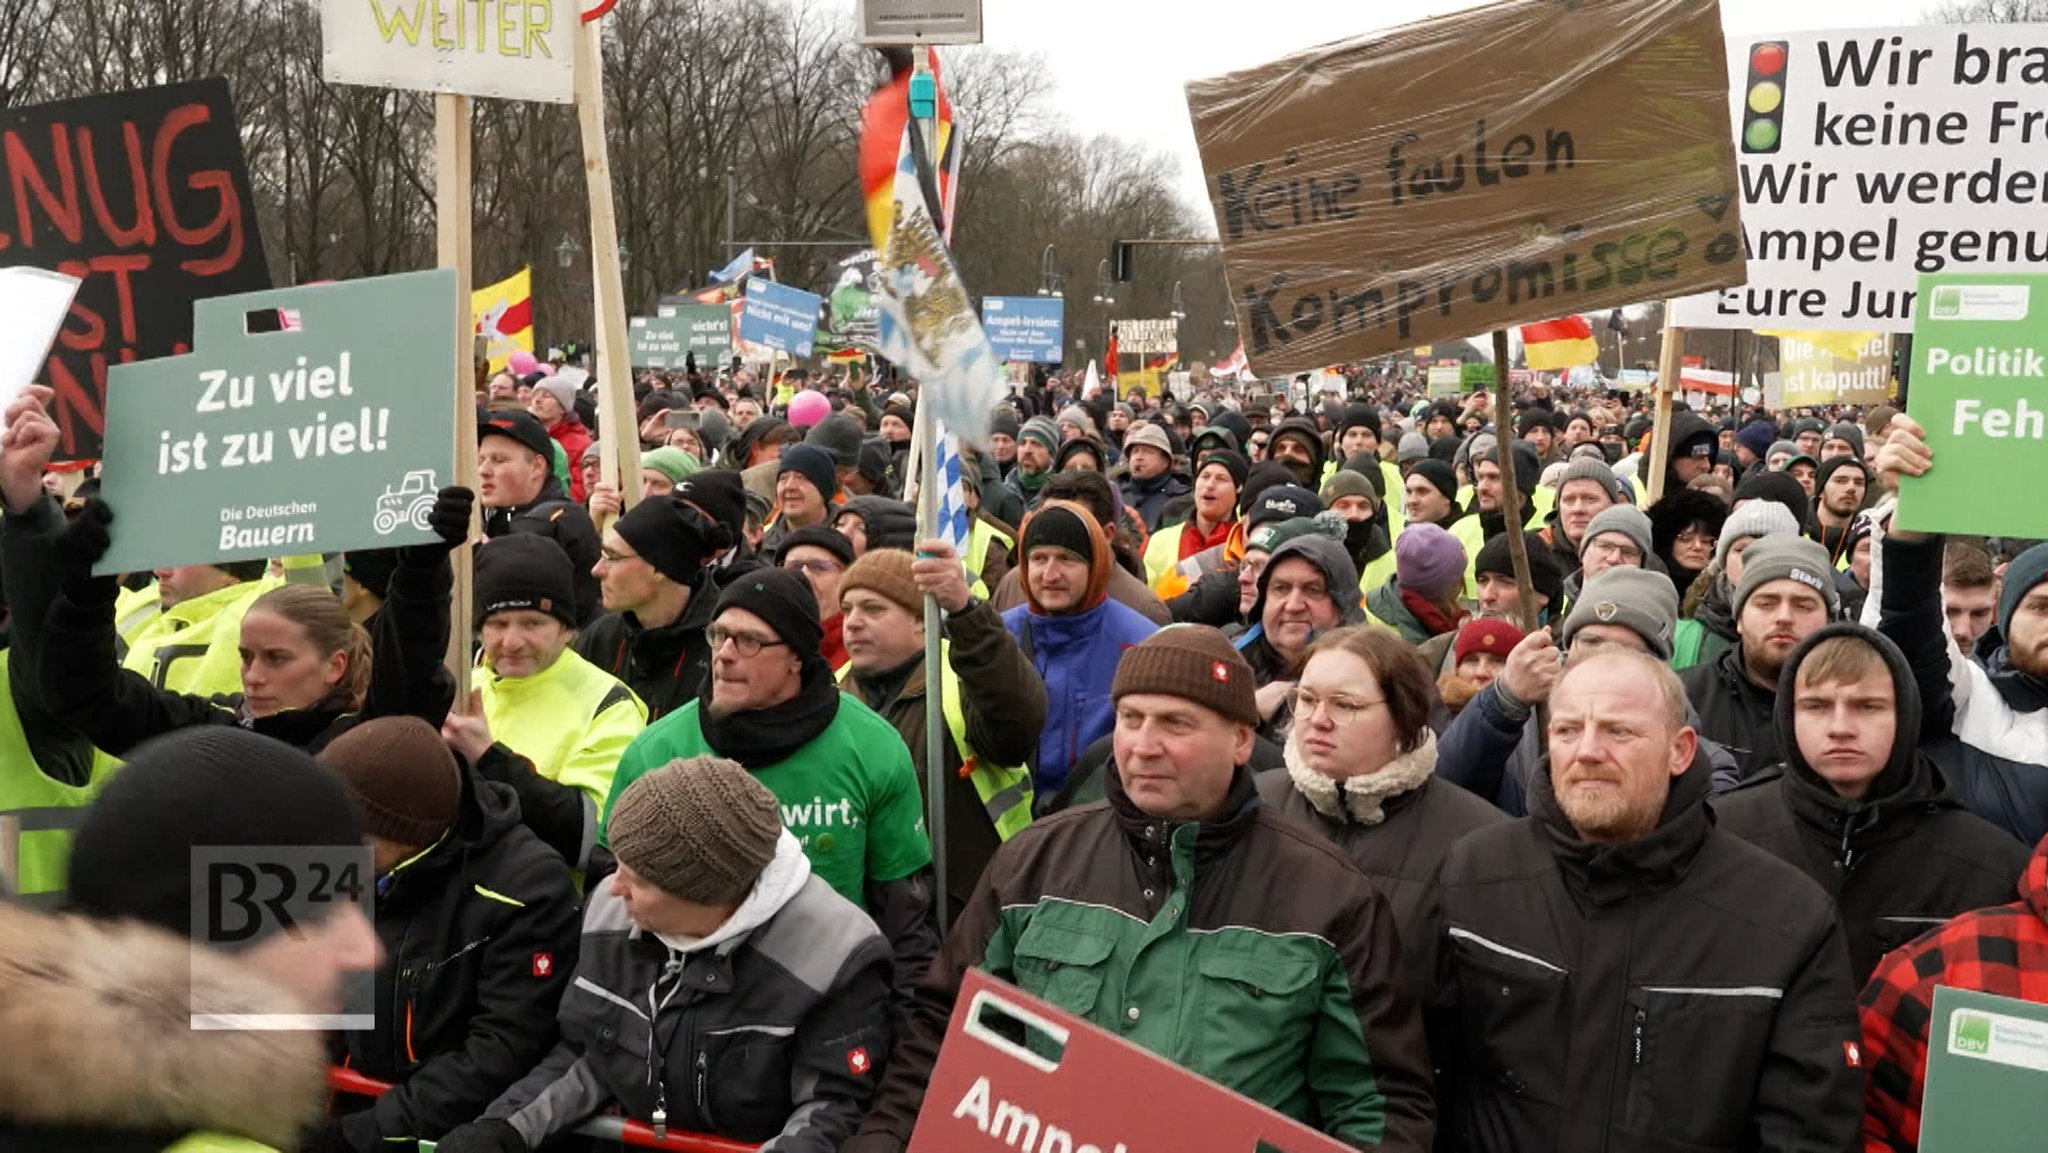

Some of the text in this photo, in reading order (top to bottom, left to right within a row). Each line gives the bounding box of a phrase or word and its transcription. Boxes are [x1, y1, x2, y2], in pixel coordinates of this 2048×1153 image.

[370, 0, 552, 58] WEITER
[1817, 33, 2048, 87] Wir bra
[1814, 101, 2048, 145] keine Fr
[0, 103, 245, 275] NUG
[1218, 119, 1575, 240] Keine faulen
[1740, 158, 2048, 204] Wir werde
[56, 254, 152, 350] ST
[691, 320, 728, 332] eicht's!
[196, 350, 353, 413] Zu viel
[1785, 365, 1887, 397] ist kaputt!
[1927, 347, 2045, 377] Politik
[158, 406, 390, 475] ist zu viel!
[1953, 398, 2044, 439] Feh
[220, 501, 317, 523] Die Deutschen
[219, 522, 315, 551] Bauern
[781, 796, 859, 829] wirt,
[1957, 1036, 1986, 1052] DBV
